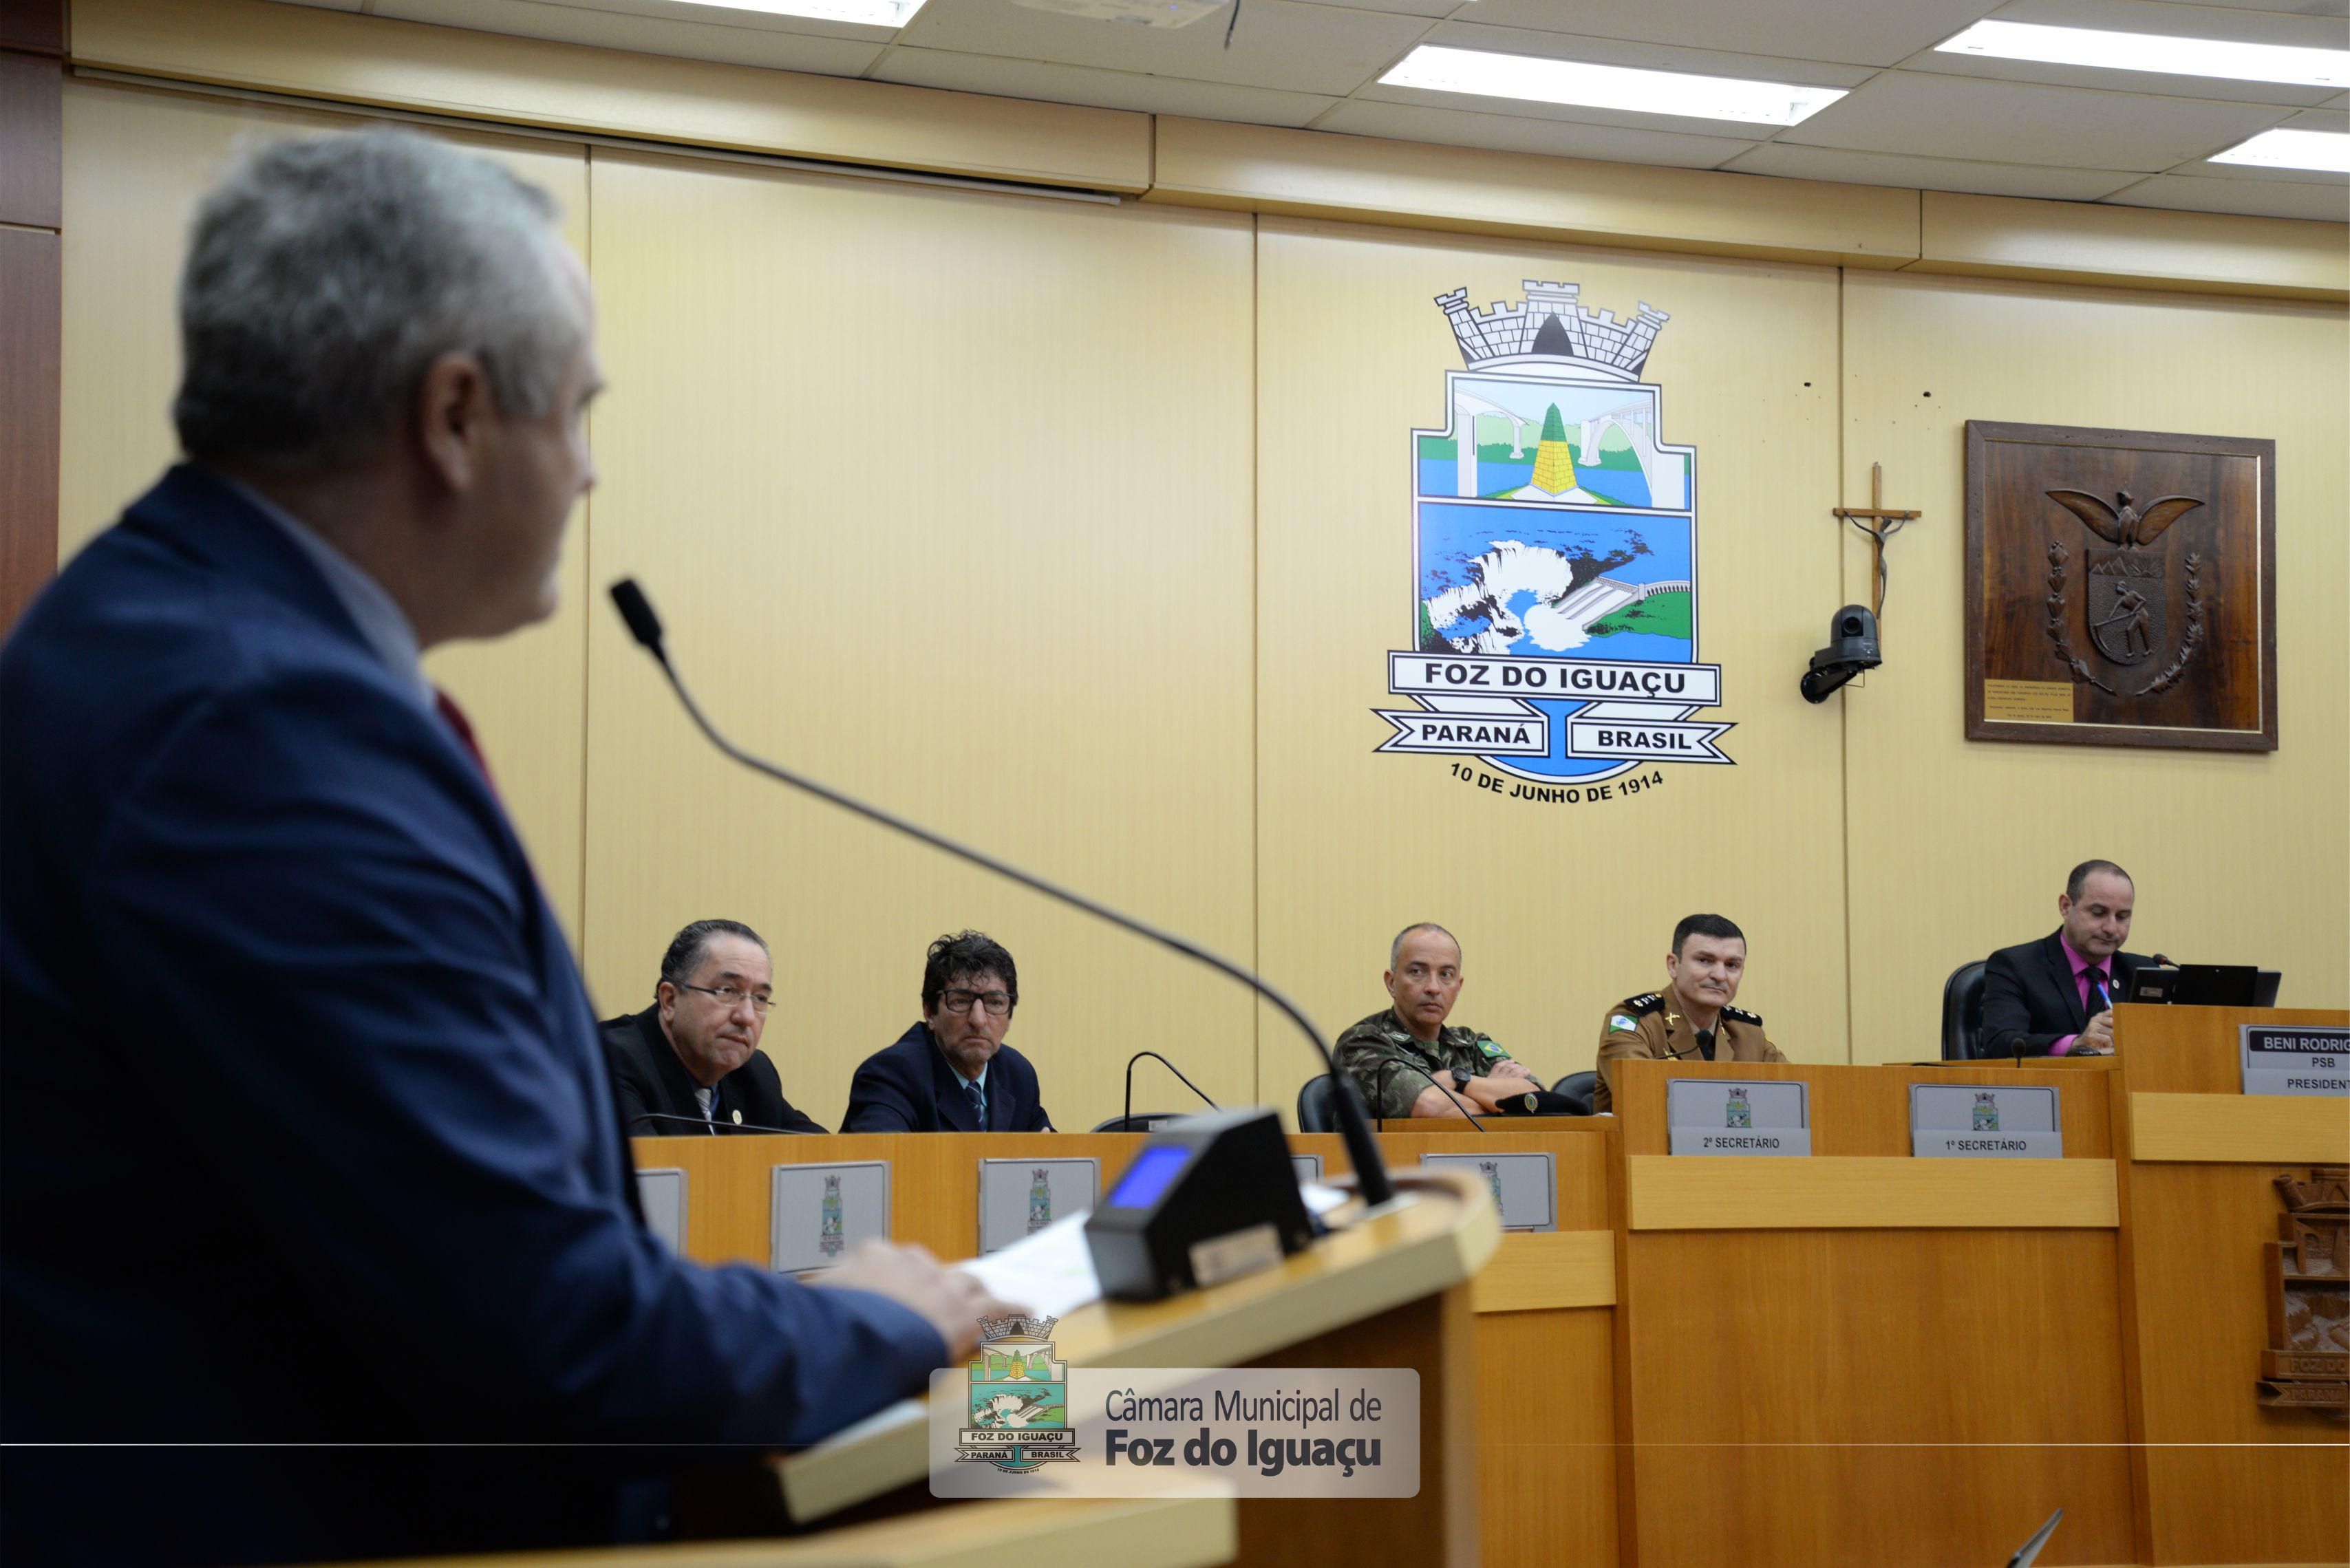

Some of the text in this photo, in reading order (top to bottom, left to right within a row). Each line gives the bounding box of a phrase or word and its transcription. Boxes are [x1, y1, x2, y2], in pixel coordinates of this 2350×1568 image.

[1426, 663, 1685, 698] FOZ DO IGUAÇU
[1422, 723, 1530, 744] PARANÁ
[1598, 730, 1692, 750] BRASIL
[1451, 763, 1663, 804] 10 DE JUNHO DE 1914
[2264, 1037, 2296, 1050] BENI
[2312, 1057, 2335, 1068] PSB
[1703, 1135, 1780, 1148] 2º SECRETÁRIO
[1945, 1138, 2027, 1151] 1º SECRETÁRIO
